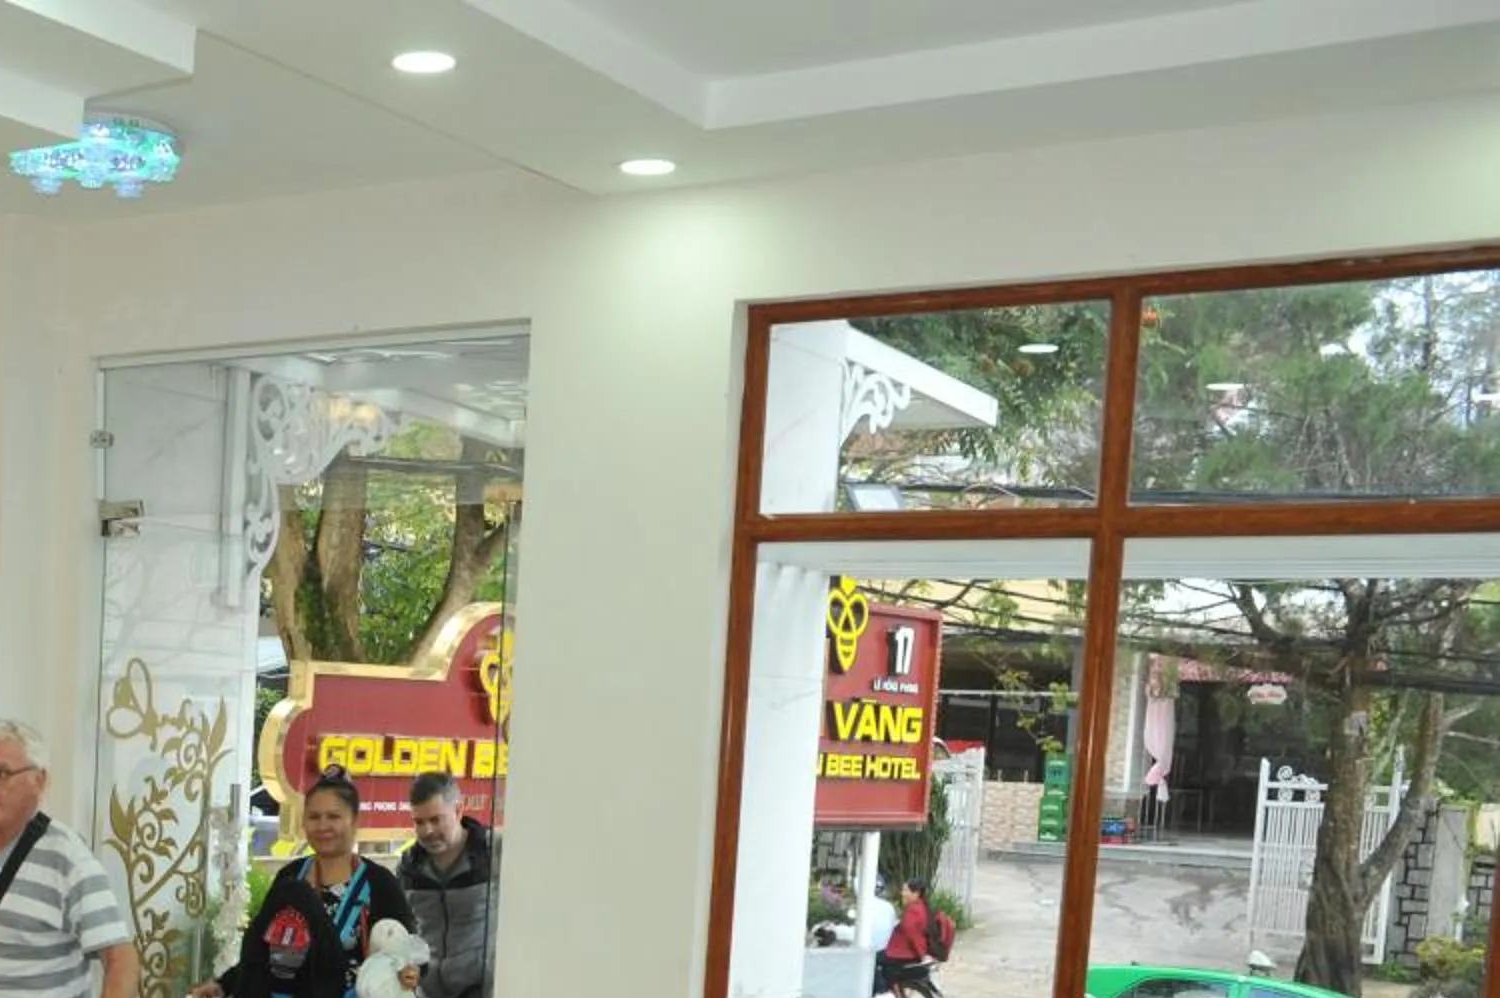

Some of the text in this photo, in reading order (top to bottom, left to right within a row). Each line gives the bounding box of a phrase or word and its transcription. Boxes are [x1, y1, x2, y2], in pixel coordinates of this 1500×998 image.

[319, 735, 509, 778] GOLDEN BE
[826, 753, 863, 777] BEE
[865, 755, 921, 780] HOTEL
